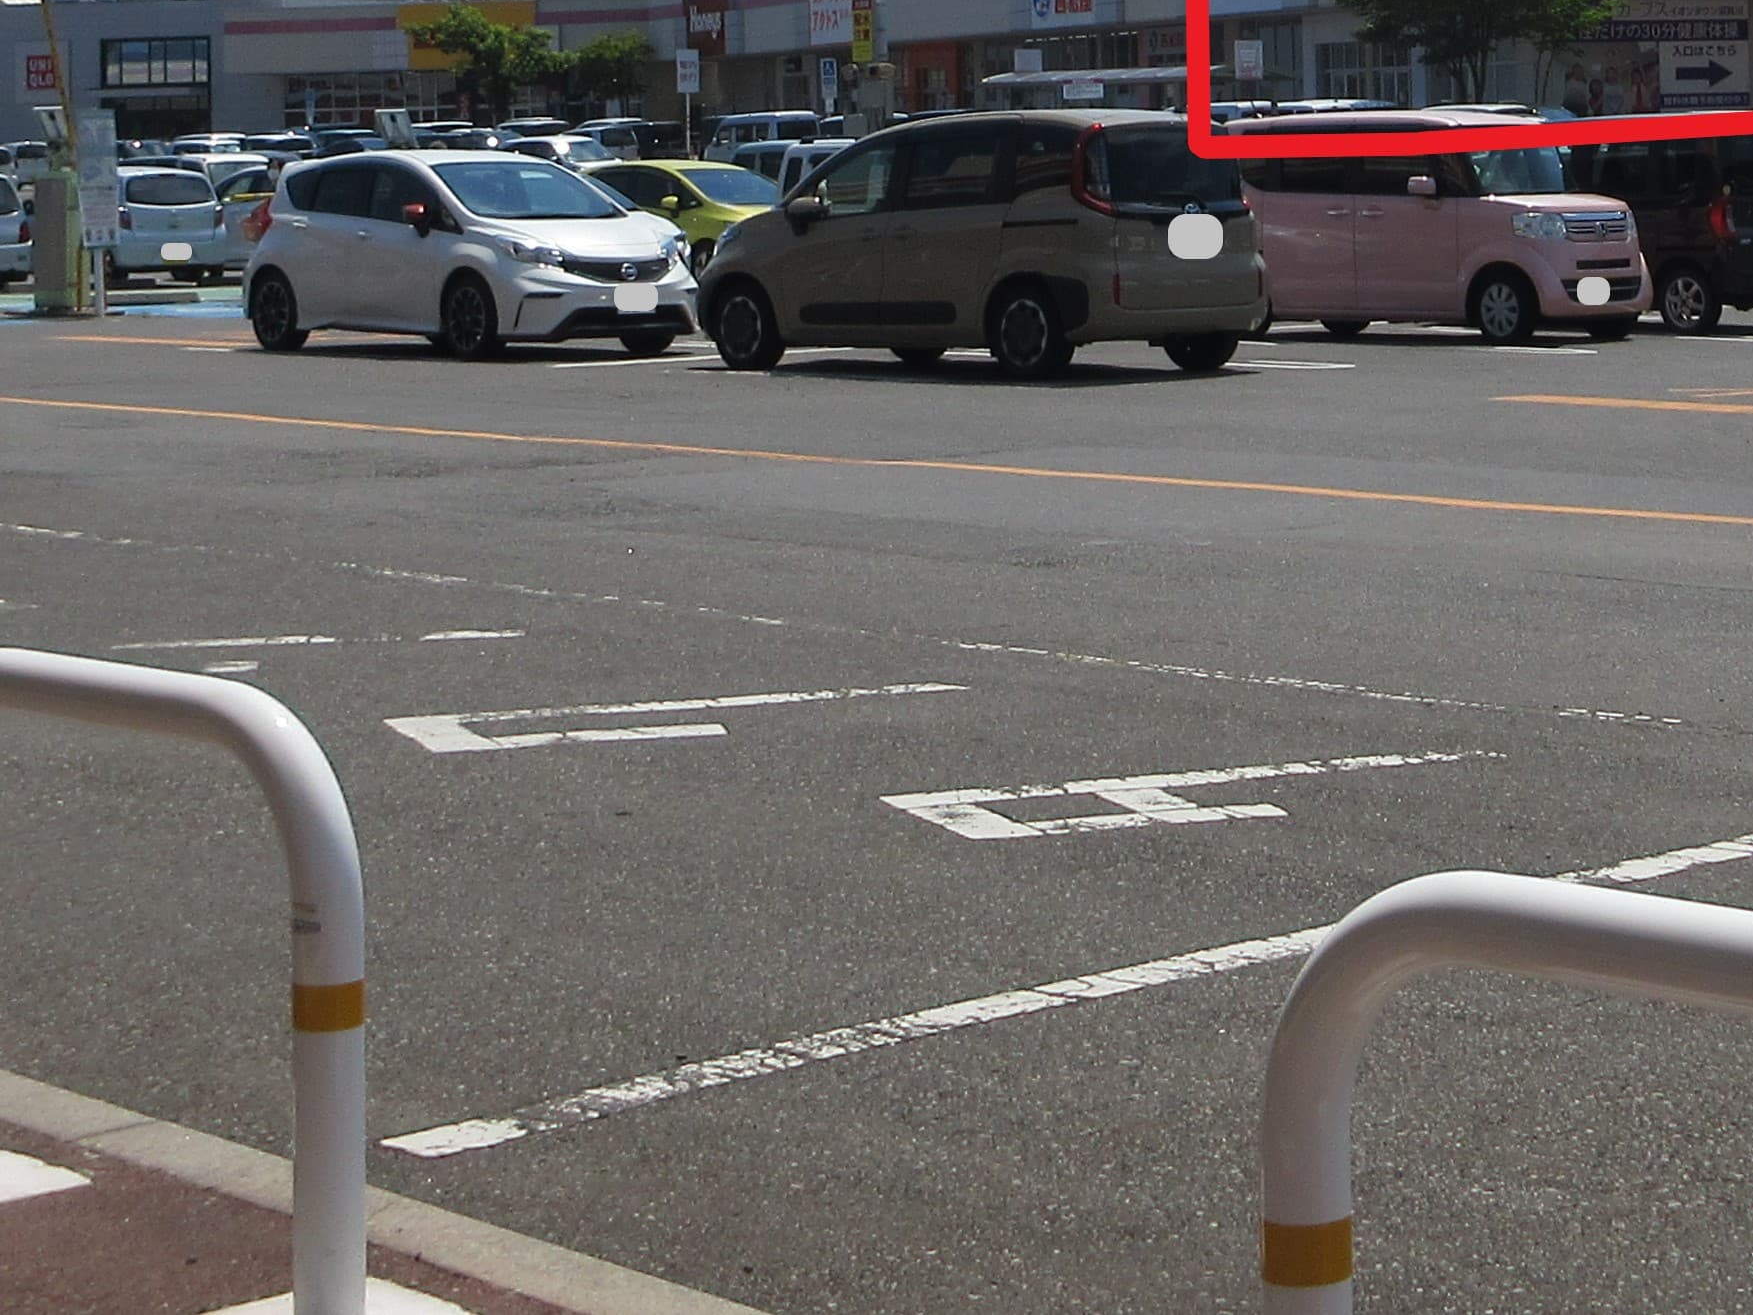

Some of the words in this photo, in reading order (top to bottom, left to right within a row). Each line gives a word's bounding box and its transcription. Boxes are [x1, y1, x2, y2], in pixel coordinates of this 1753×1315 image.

[1671, 44, 1738, 57] 入口はこちら
